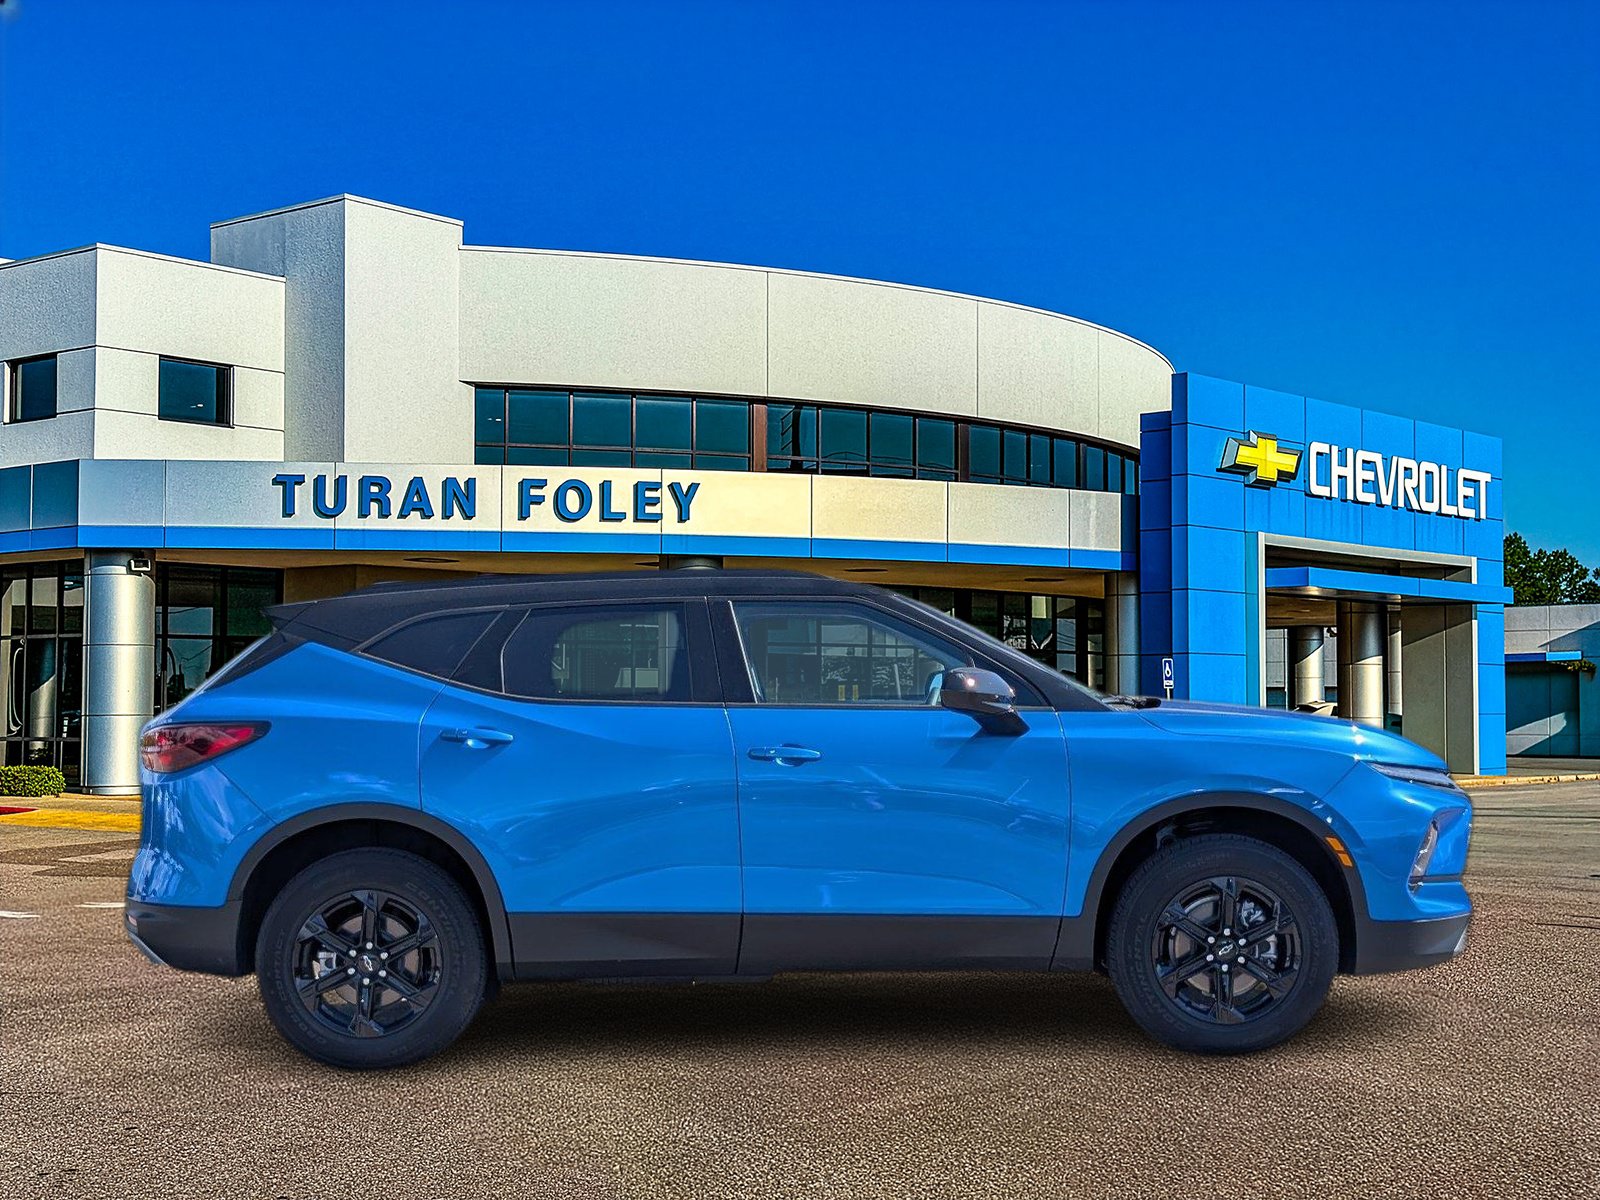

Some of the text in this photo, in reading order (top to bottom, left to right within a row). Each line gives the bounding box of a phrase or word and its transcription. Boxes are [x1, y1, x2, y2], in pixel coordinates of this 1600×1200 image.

[271, 473, 701, 523] TURAN FOLEY
[1306, 441, 1492, 520] CHEVROLET
